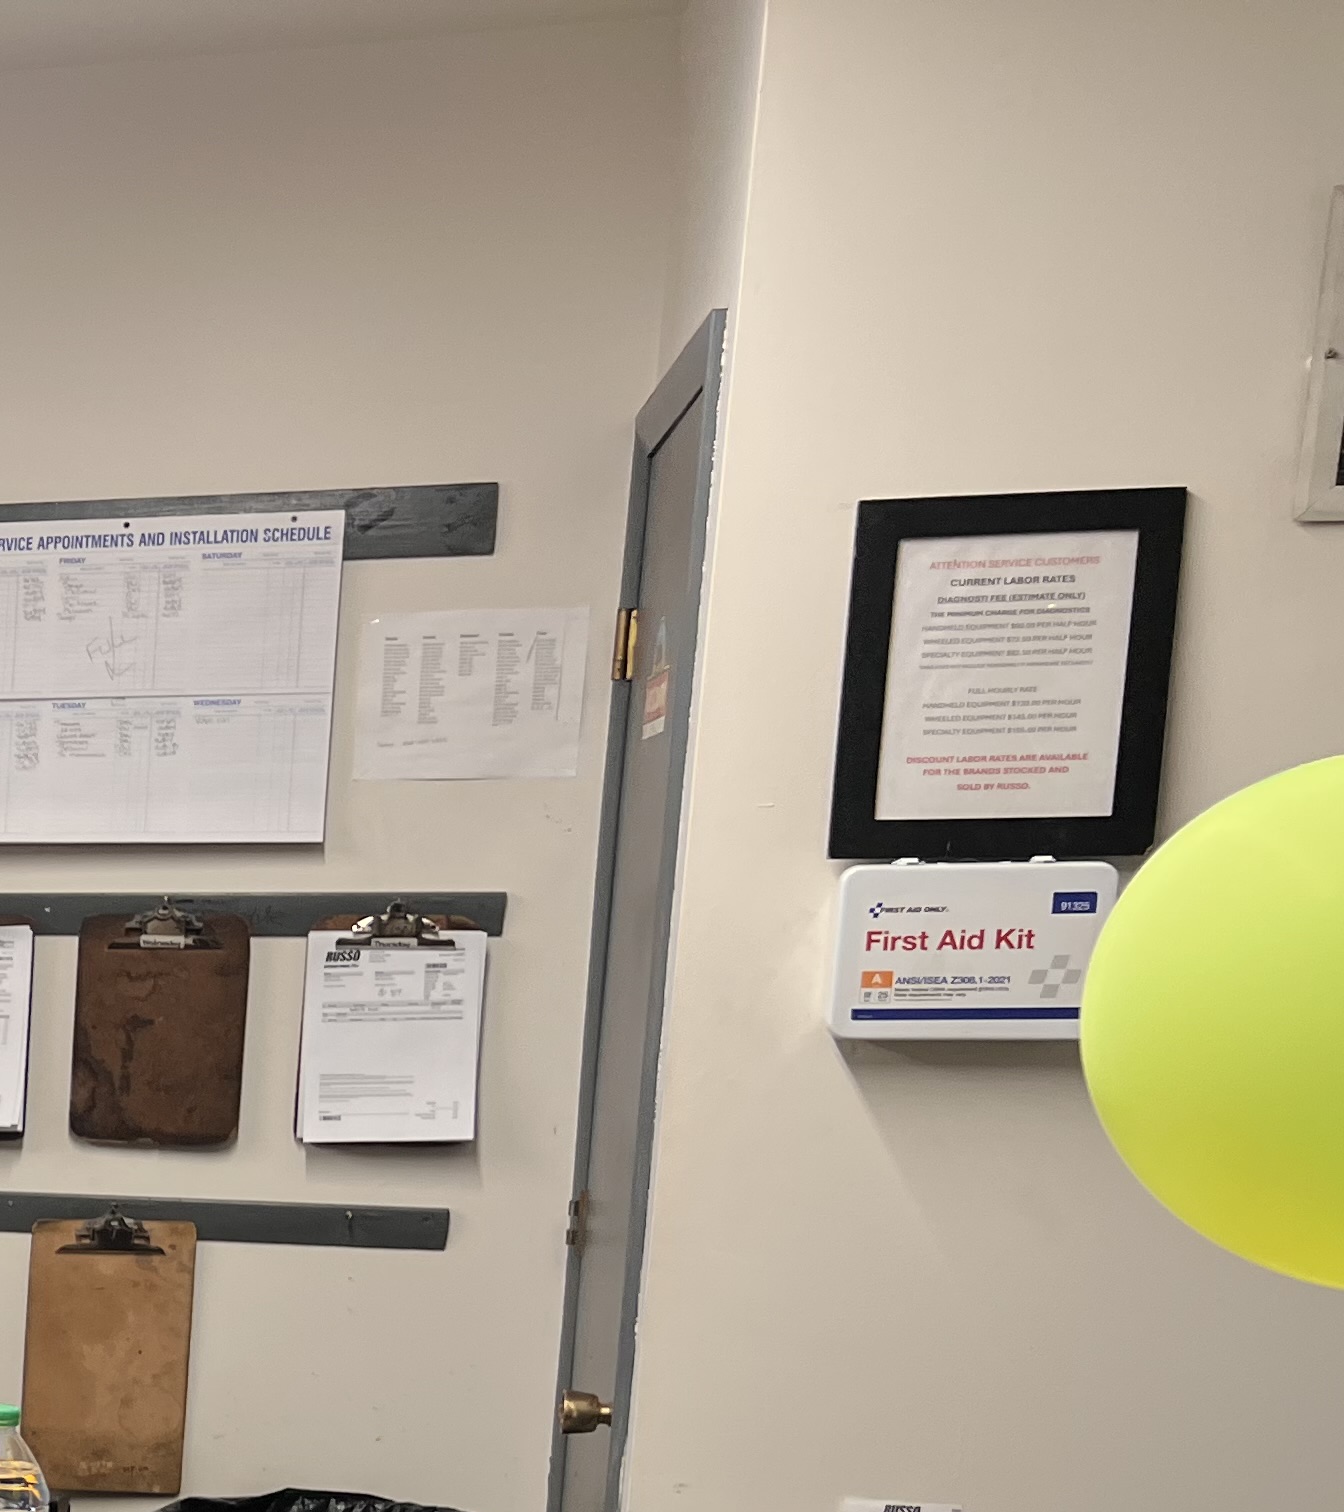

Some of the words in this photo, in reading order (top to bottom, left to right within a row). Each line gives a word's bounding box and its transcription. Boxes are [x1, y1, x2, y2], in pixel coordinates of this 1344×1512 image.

[37, 533, 134, 550] APPOINTMENTS
[139, 532, 165, 547] AND
[169, 529, 258, 546] INSTALLATION
[263, 526, 332, 543] SCHEDULE
[59, 557, 86, 565] FRIDAY
[950, 577, 1001, 587] CURRENT
[1003, 575, 1040, 585] LABOR
[1042, 574, 1076, 584] RATES
[865, 930, 929, 951] First
[937, 929, 985, 951] Aid
[995, 928, 1036, 950] Kit
[325, 950, 360, 963] RUSSO
